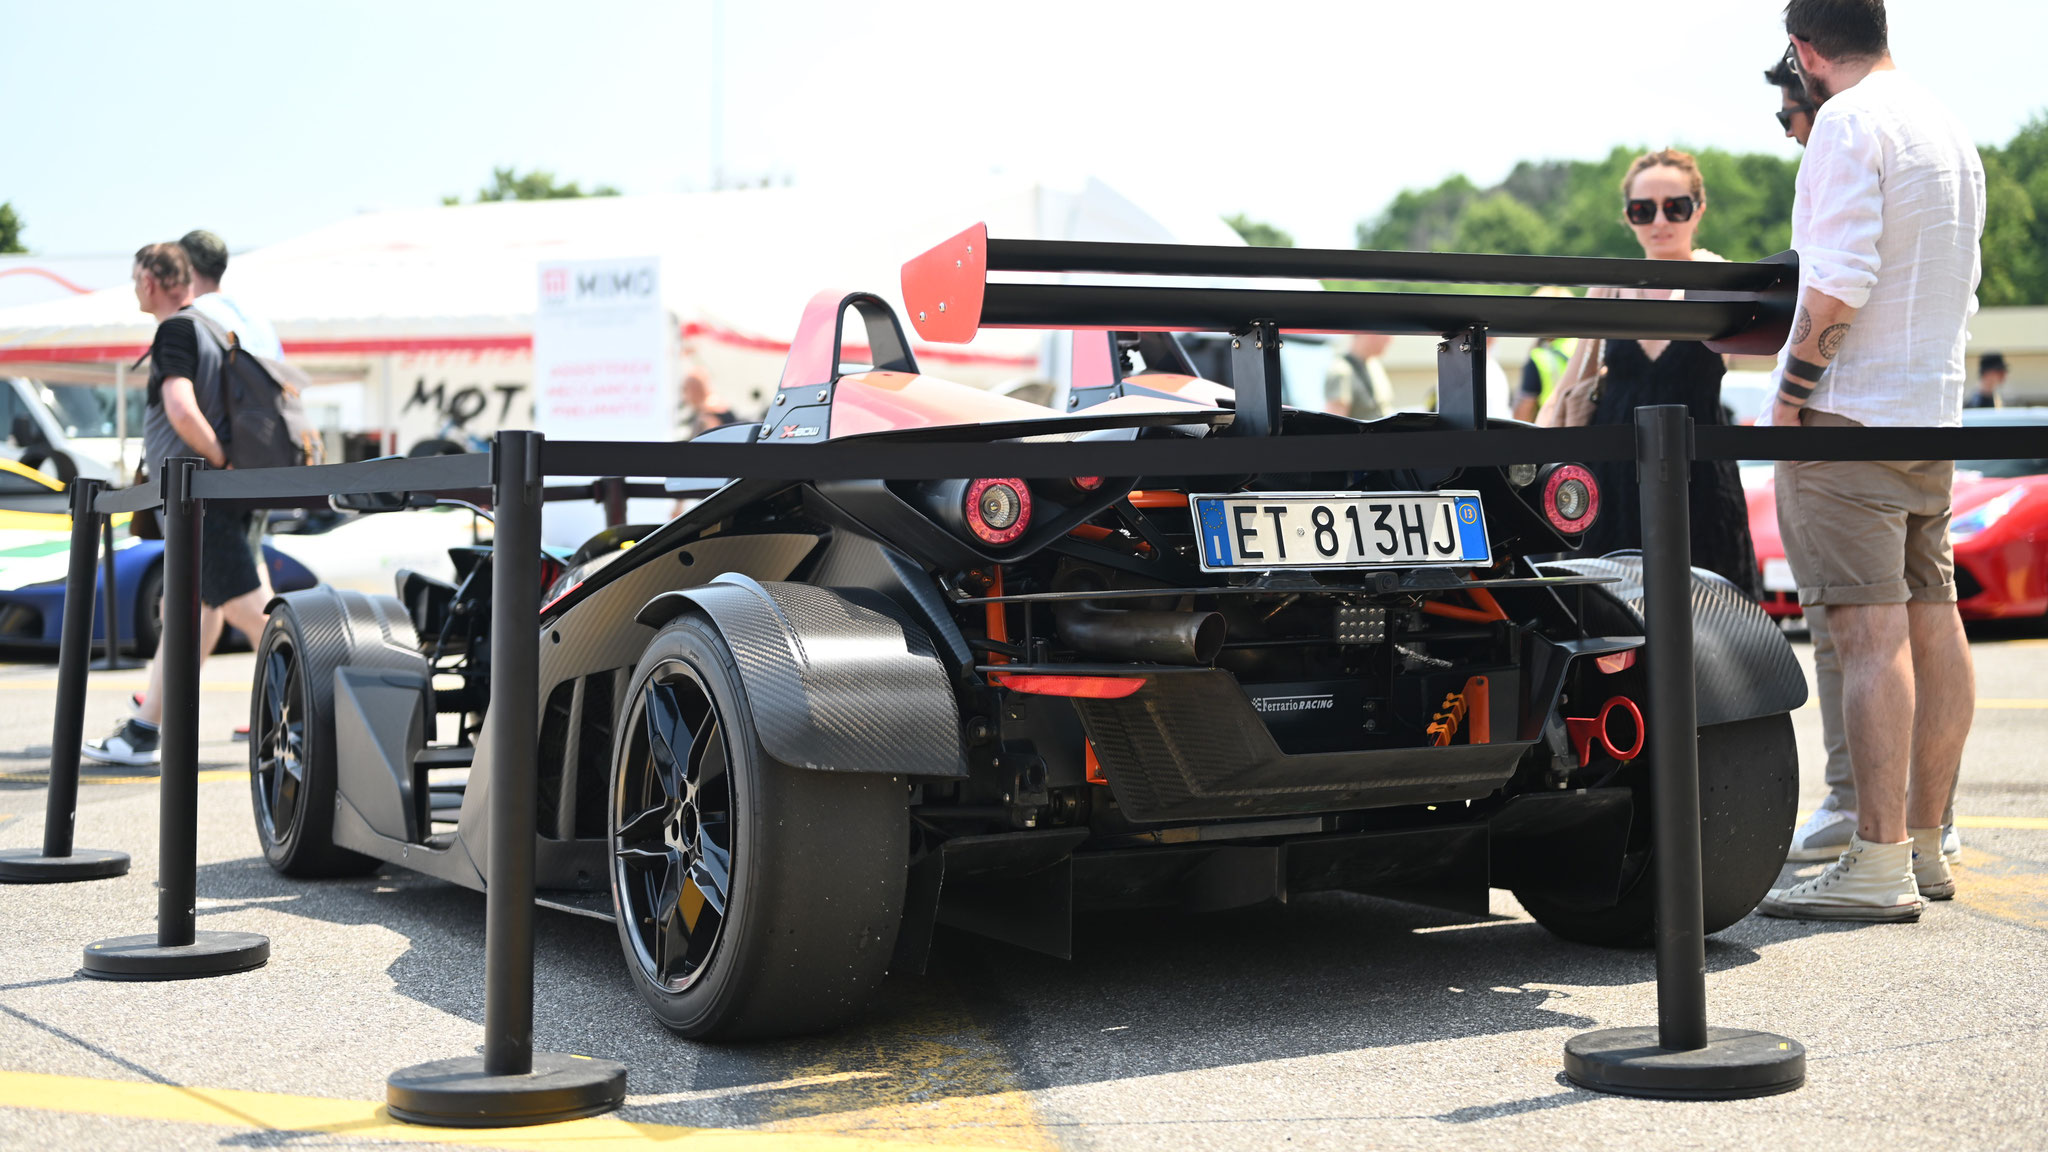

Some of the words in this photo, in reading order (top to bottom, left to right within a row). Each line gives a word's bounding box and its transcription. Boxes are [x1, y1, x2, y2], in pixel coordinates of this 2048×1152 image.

[576, 268, 655, 300] MIMO
[402, 377, 535, 425] MOT
[1462, 508, 1475, 520] 13
[1212, 535, 1222, 560] I
[1232, 505, 1288, 560] ET
[1311, 503, 1456, 557] 813HJ
